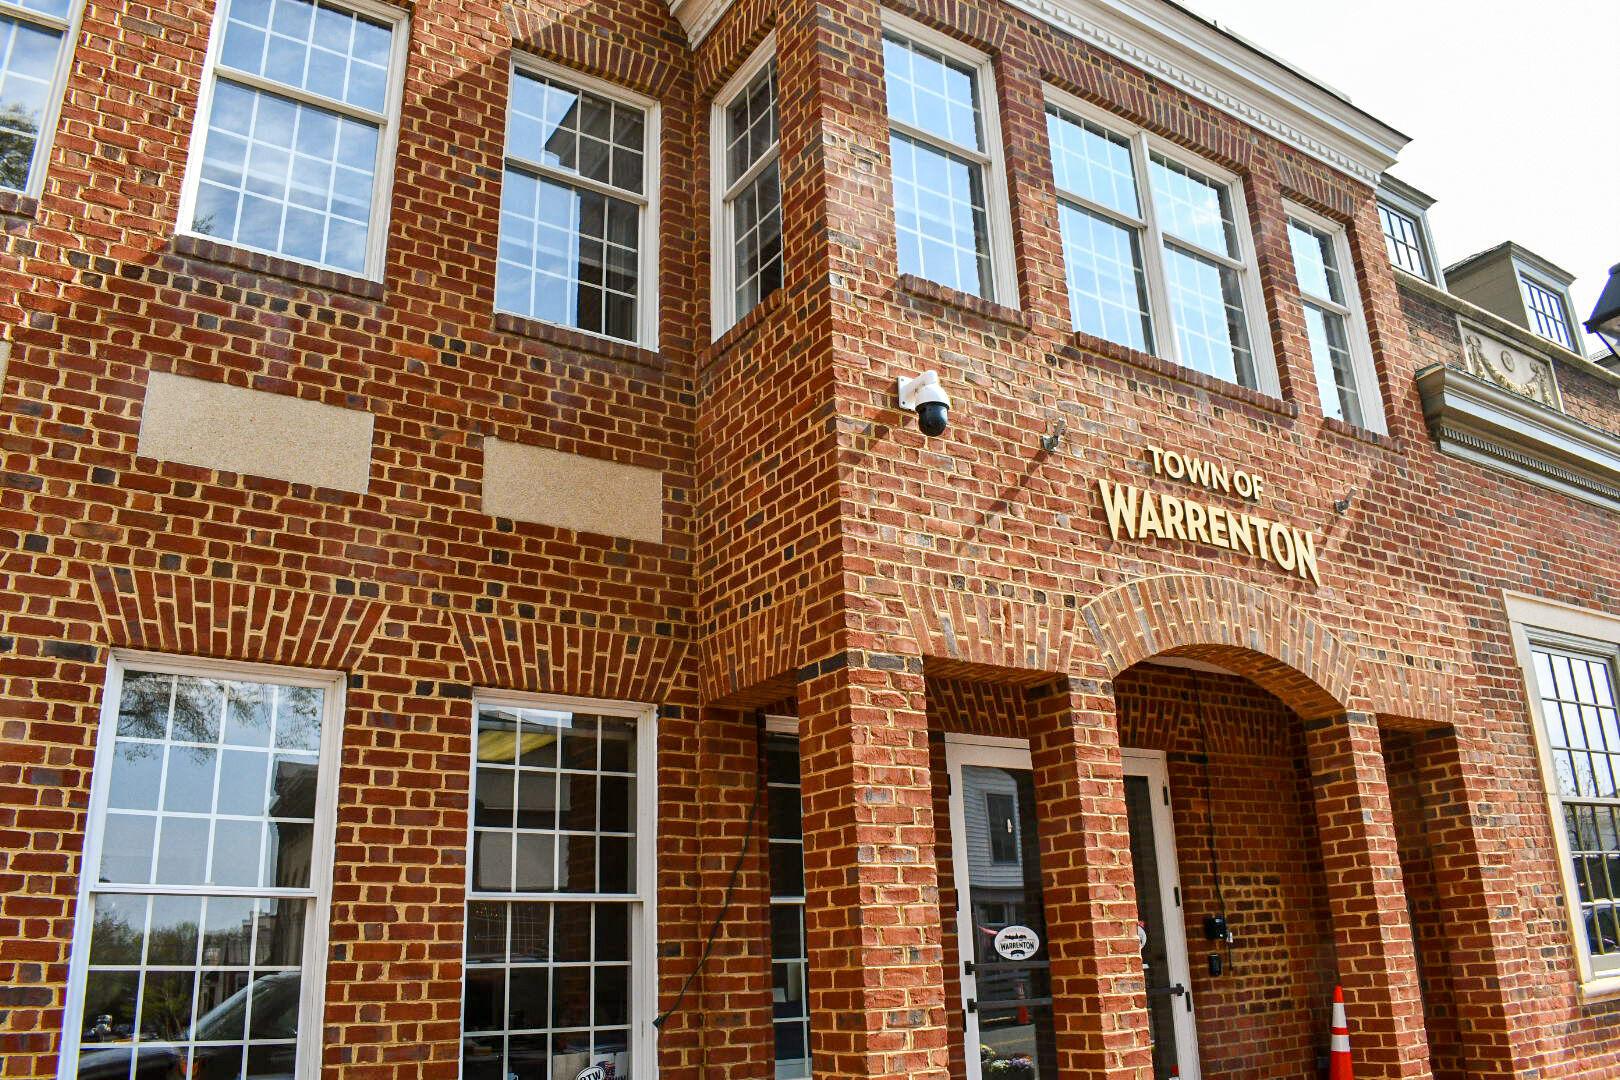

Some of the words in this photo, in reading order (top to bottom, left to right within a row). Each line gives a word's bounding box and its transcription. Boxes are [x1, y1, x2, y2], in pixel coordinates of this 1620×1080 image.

[1147, 445, 1230, 493] TOWN
[1233, 470, 1264, 500] OF
[1098, 478, 1320, 587] WARRENTON
[1000, 941, 1035, 951] WARRENTON
